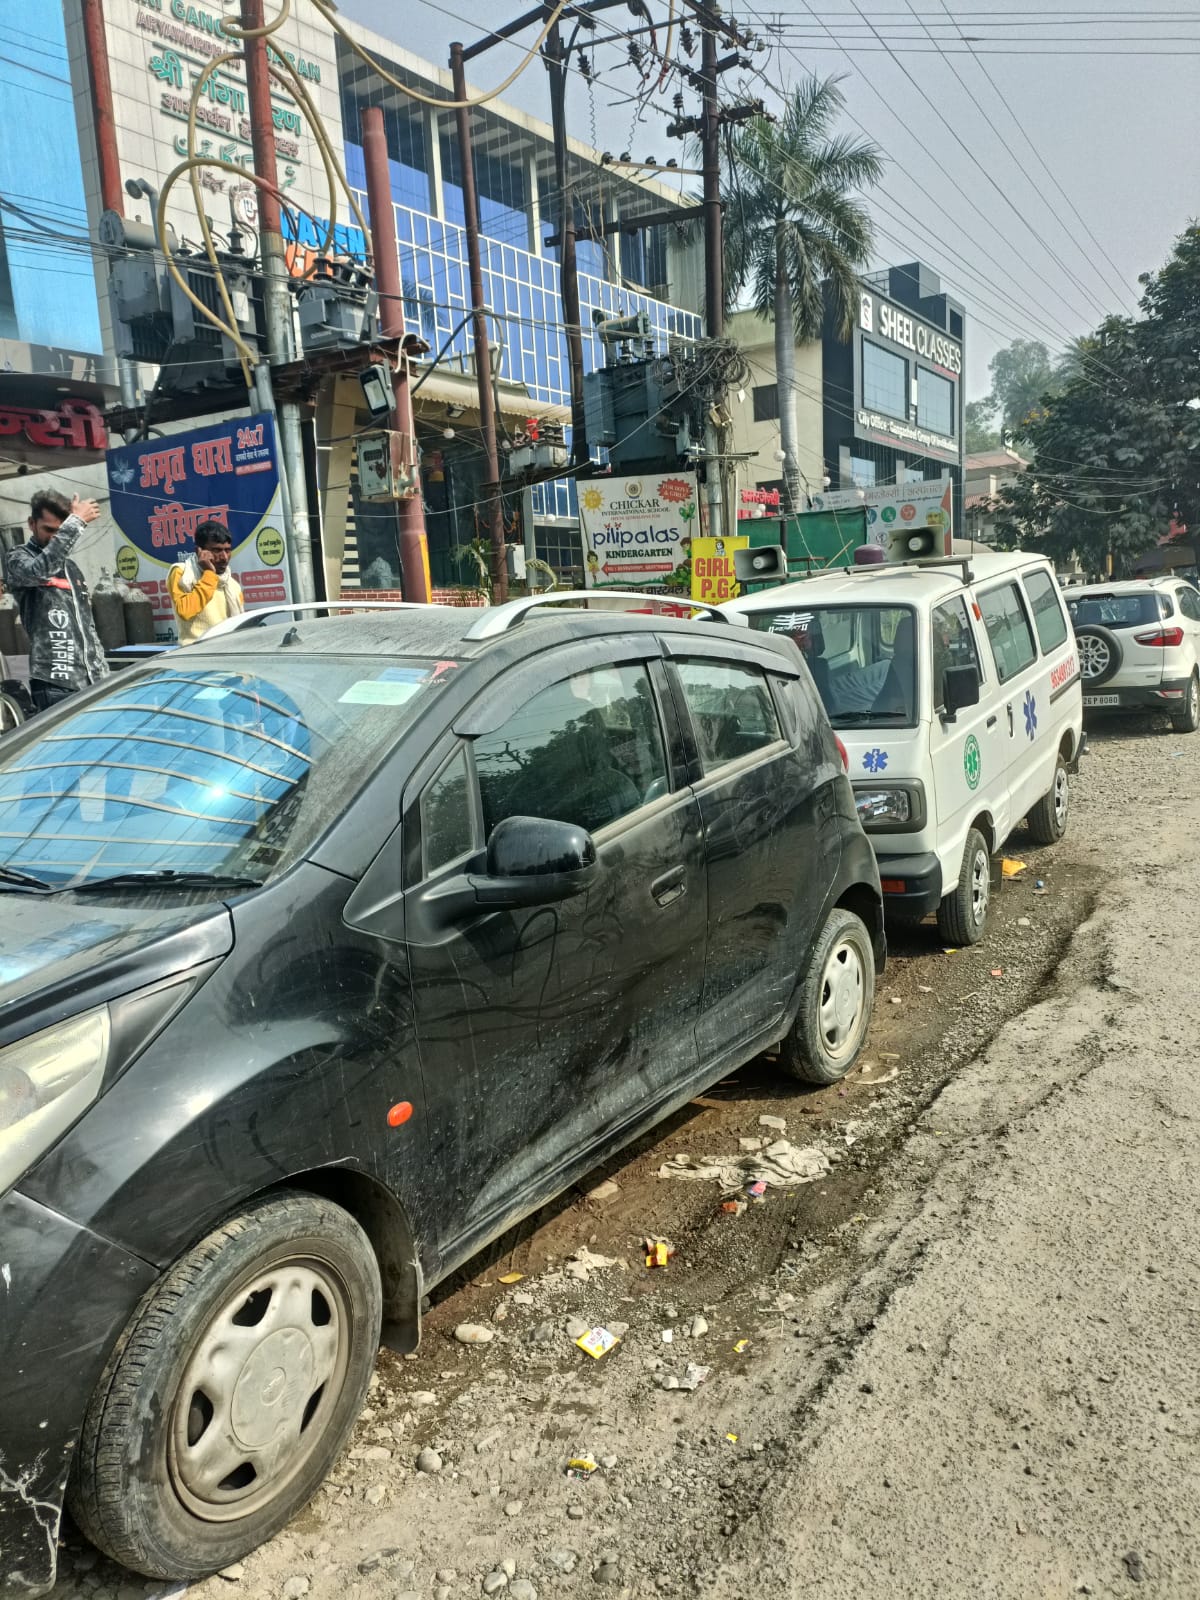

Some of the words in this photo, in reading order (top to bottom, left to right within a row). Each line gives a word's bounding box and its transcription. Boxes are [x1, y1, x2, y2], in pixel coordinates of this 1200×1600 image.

[881, 304, 916, 352] SHEEL
[916, 325, 961, 375] CLASSES
[237, 423, 264, 449] 24x7
[138, 446, 187, 495] अमृत
[609, 499, 661, 511] CHICKAR
[593, 525, 680, 549] pilipalas
[605, 547, 673, 559] KINDERGARTEN
[48, 630, 70, 680] EMPIRE
